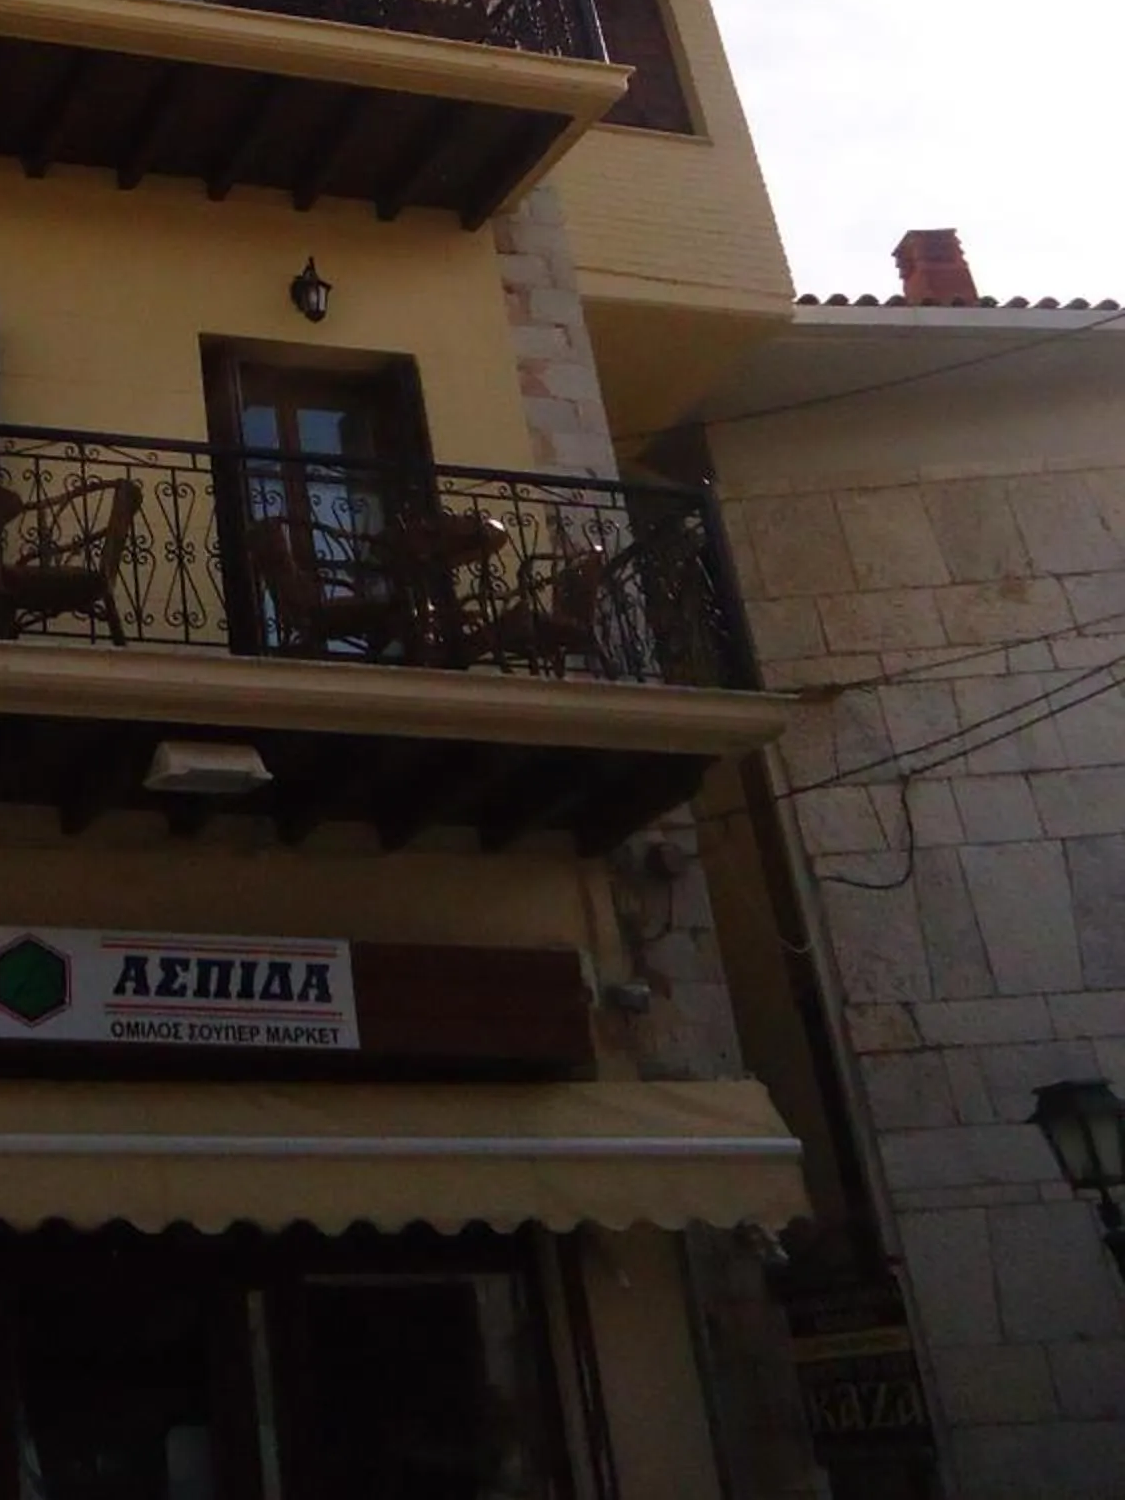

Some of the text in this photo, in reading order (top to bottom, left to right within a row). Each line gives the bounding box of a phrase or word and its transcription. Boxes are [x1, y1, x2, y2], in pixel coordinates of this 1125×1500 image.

[113, 956, 332, 1003] ΑΣΠΙΔΑ
[110, 1020, 340, 1046] ΟΜΙΛΟΣ ΣΟΥΠΕΡ ΜΑΡΚΕΤ
